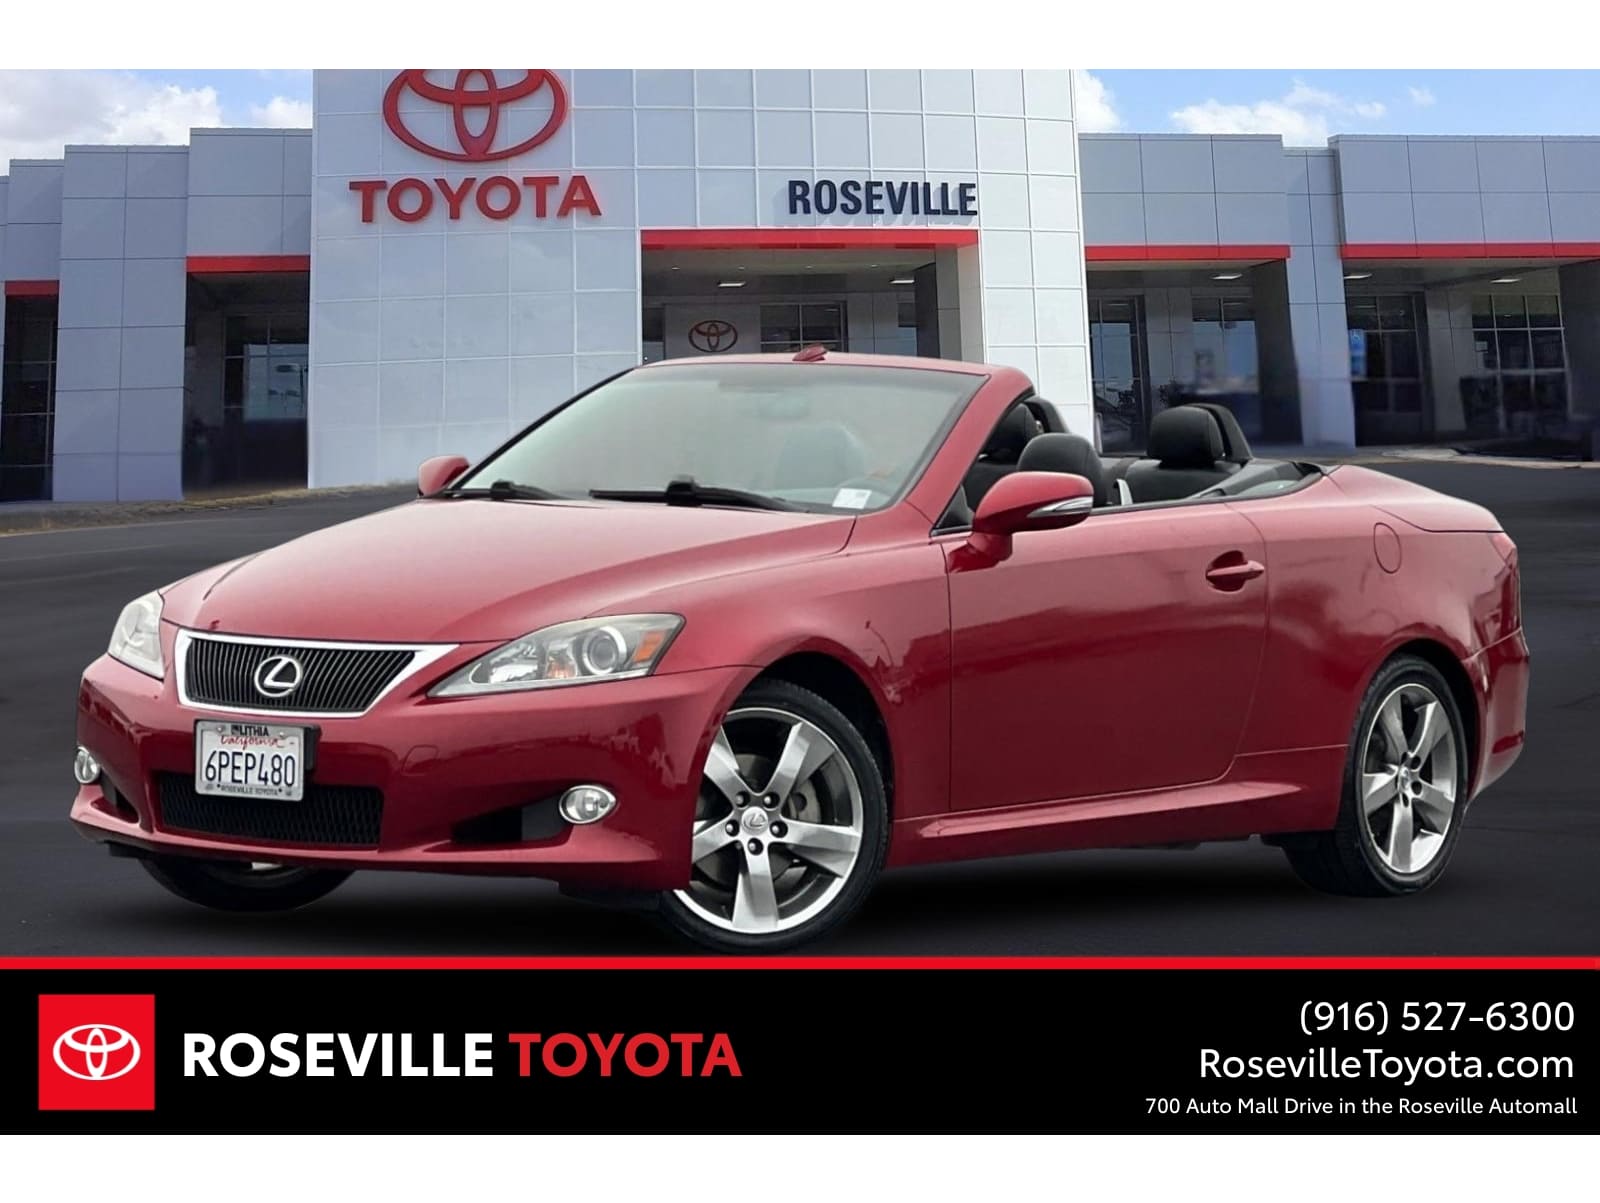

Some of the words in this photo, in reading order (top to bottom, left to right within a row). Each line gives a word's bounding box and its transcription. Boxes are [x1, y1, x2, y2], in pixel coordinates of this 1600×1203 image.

[349, 175, 602, 223] TOYOTA
[788, 179, 979, 217] ROSEVILLE
[220, 735, 285, 751] California
[239, 725, 269, 737] LITHIA
[205, 750, 296, 787] 6PEP480
